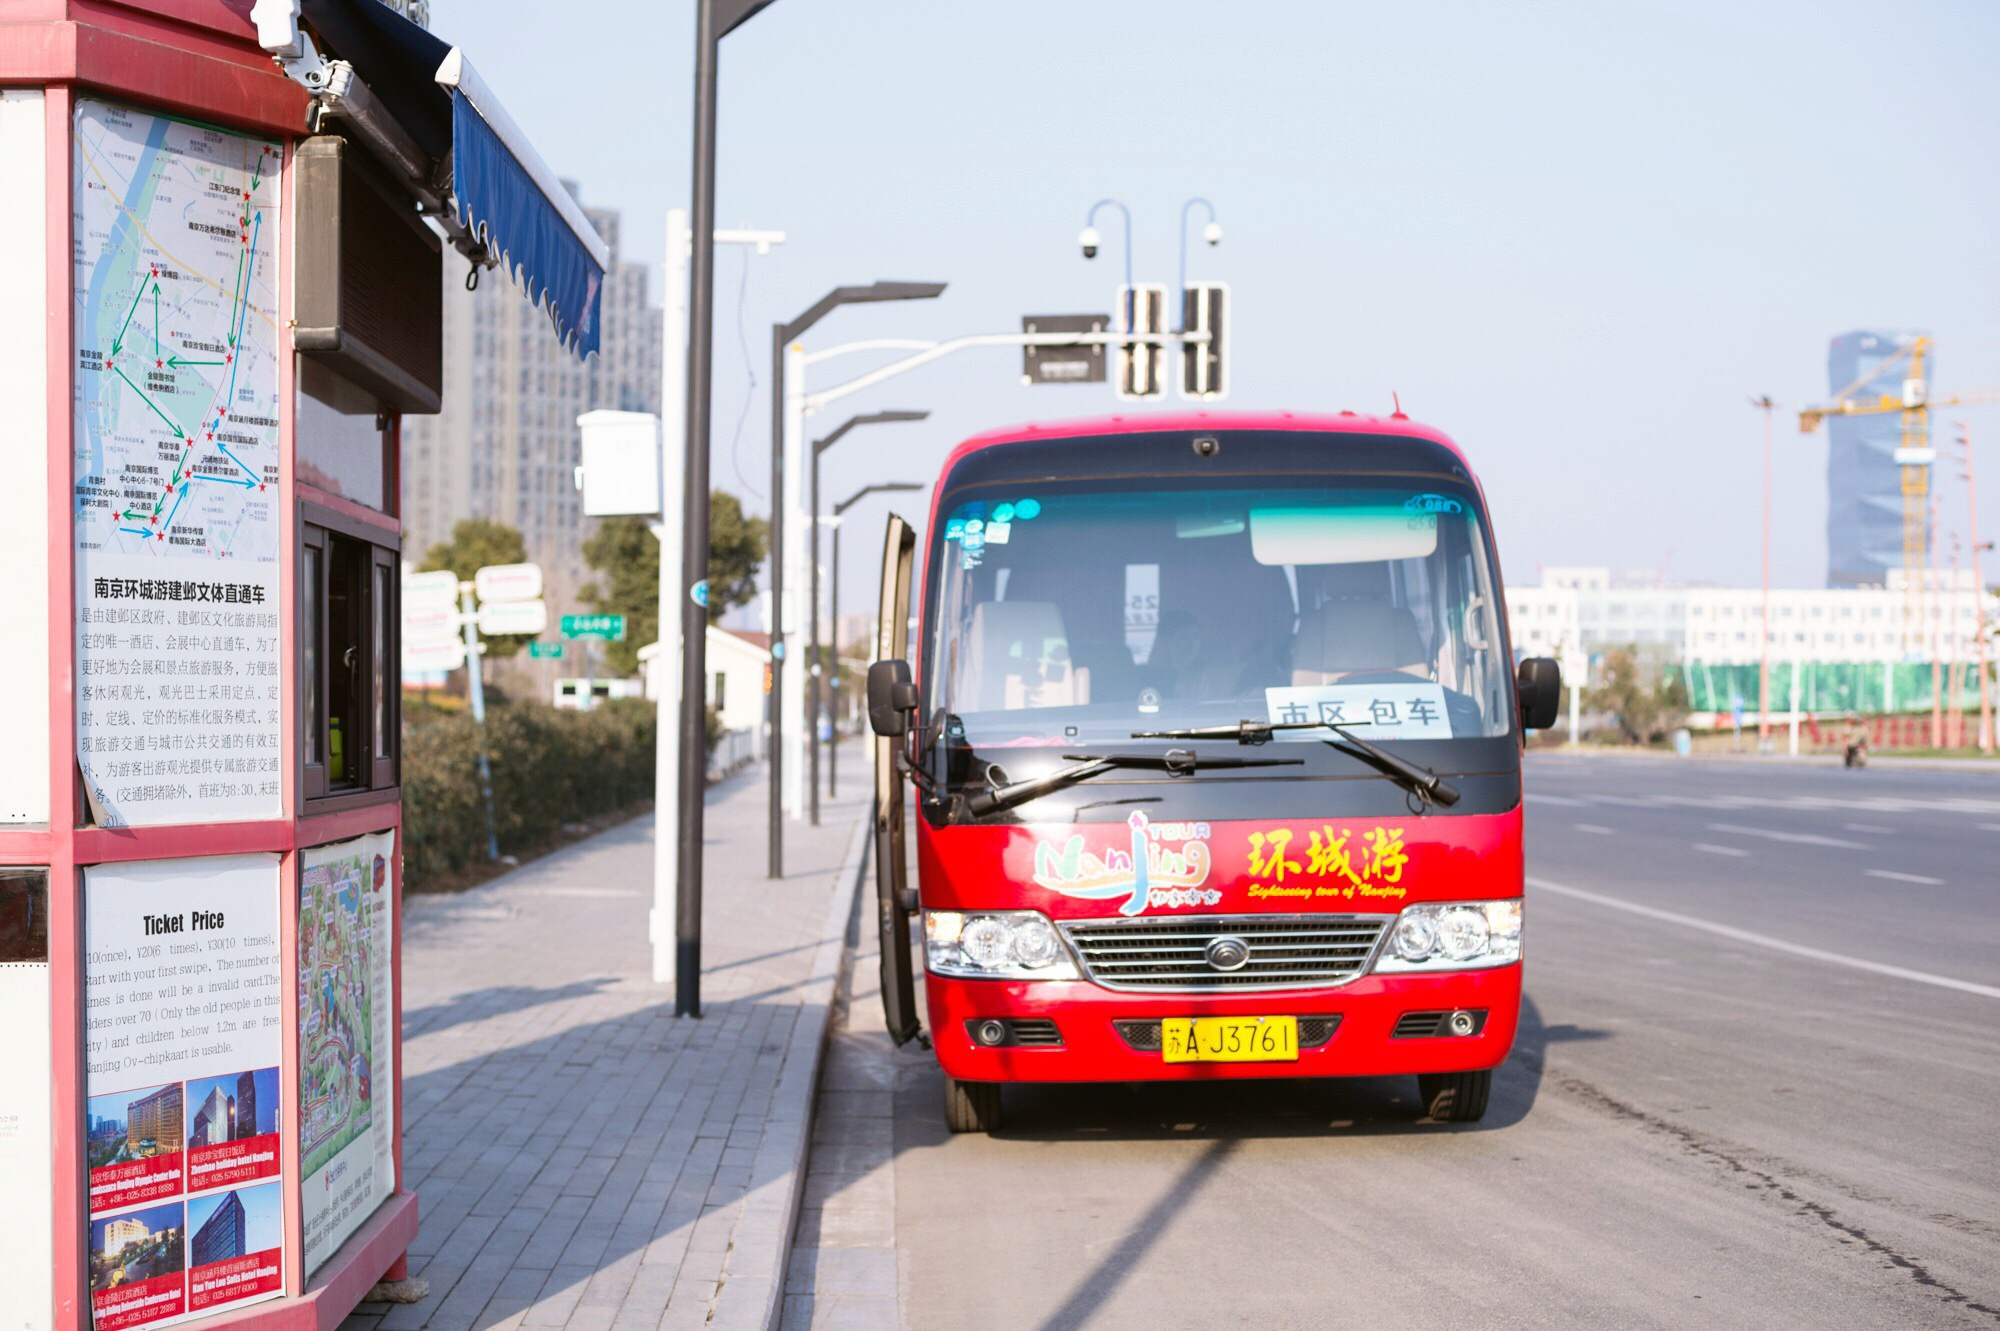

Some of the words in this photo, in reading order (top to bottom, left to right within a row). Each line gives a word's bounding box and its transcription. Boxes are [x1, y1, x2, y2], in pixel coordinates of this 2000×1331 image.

[208, 182, 241, 196] 江东门纪念馆
[188, 221, 237, 238] 南京万达希尔顿酒店
[161, 270, 179, 280] 绿博园
[79, 349, 103, 360] 南京金陵
[182, 340, 226, 354] 南京珍宝假日酒店
[79, 360, 103, 372] 滨江酒店
[147, 371, 175, 383] 金陵图书馆
[158, 441, 180, 451] 南京华泰
[158, 452, 180, 462] 万丽酒店
[125, 464, 159, 475] 南京国际博览
[191, 464, 239, 477] 南京金奥费尔蒙酒店
[88, 476, 106, 486] 青奥村
[123, 490, 158, 501] 南京国际博览
[129, 501, 152, 511] 中心酒店
[170, 525, 204, 536] 南京新华传媒
[168, 536, 207, 547] 粤海国际大酒店
[94, 577, 265, 604] 南京环城游建邺文体直通车
[81, 607, 278, 628] 是由建邺区政府、建邺区文化旅游局指
[81, 633, 278, 652] 定的唯一酒店、会展中心直通车，为了
[81, 659, 278, 676] 更好地为会展和景点旅游服务，方便旅
[81, 684, 278, 701] 客休闲观光，观光巴士采用定点、定
[81, 708, 278, 727] 时、定线、定价的标准化服务模式，实
[1277, 701, 1346, 725] 市区
[1368, 698, 1440, 726] 包车
[81, 733, 279, 753] 现旅游交通与城市公共交通的有效互
[1150, 823, 1211, 840] TOUR
[1247, 825, 1409, 885] 环城游
[1247, 883, 1313, 900] Sightseeing
[1315, 885, 1339, 897] tour
[1341, 885, 1356, 900] of
[1358, 884, 1408, 899] Nanjing
[143, 913, 184, 936] Ticket
[191, 910, 225, 931] Price
[109, 971, 132, 984] with
[133, 969, 156, 983] your
[158, 965, 177, 978] first
[216, 958, 234, 971] The
[235, 955, 270, 969] number
[87, 996, 110, 1008] imes
[115, 993, 125, 1005] is
[129, 990, 153, 1003] done
[158, 986, 177, 999] will
[181, 985, 193, 996] be
[197, 985, 204, 994] a
[208, 978, 239, 993] invalid
[115, 1015, 136, 1026] over
[140, 1010, 151, 1022] 70
[185, 1004, 200, 1016] the
[202, 1001, 218, 1014] old
[220, 998, 251, 1014] people
[253, 996, 262, 1008] in
[264, 993, 281, 1006] this
[111, 1035, 129, 1048] and
[136, 1030, 175, 1045] children
[181, 1025, 210, 1038] below
[242, 1019, 257, 1030] are
[191, 1047, 200, 1058] is
